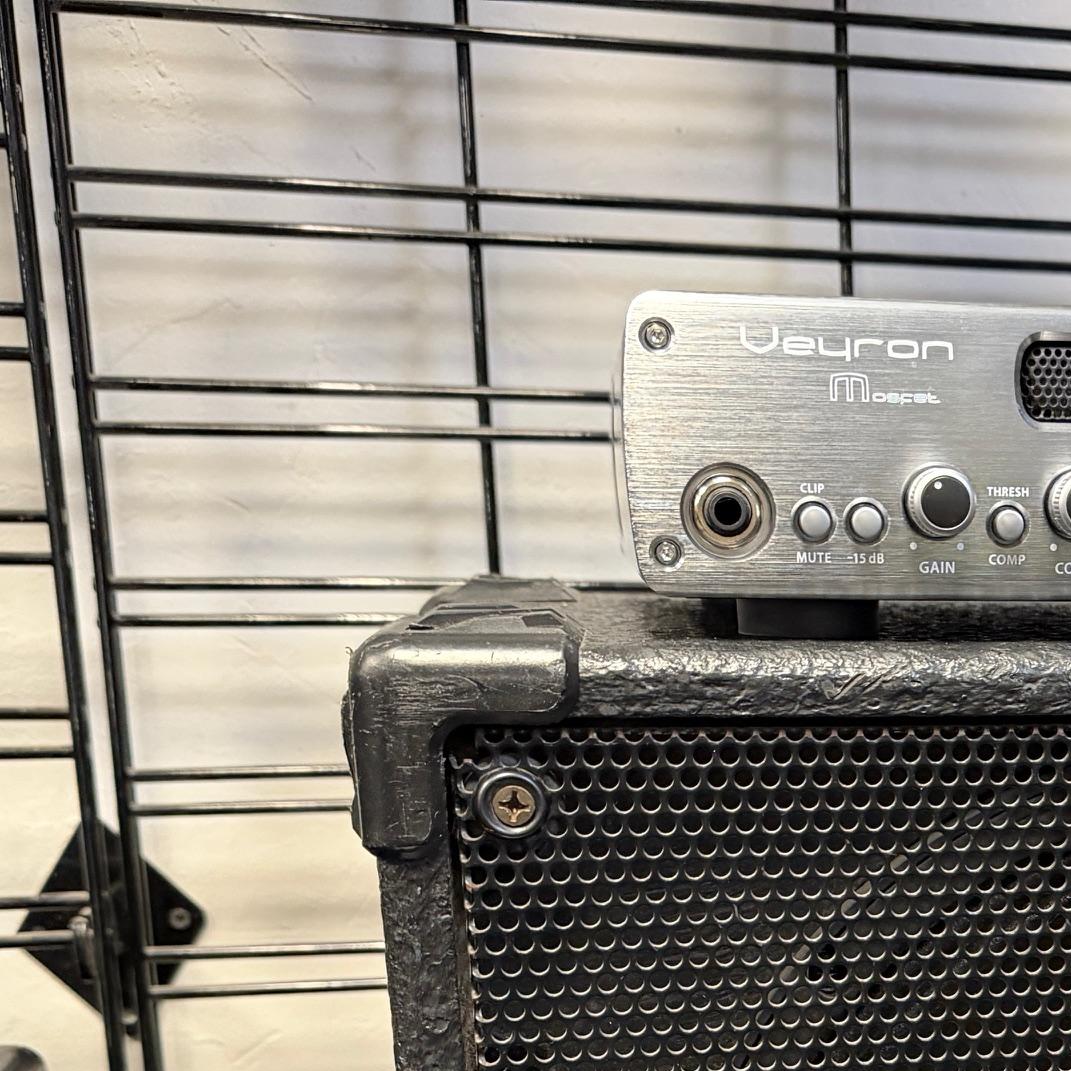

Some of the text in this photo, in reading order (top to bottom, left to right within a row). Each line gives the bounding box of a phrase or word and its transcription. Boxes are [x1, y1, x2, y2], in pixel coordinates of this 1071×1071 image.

[738, 325, 954, 361] Veyron
[800, 483, 825, 494] CLIP
[987, 486, 1029, 498] THRESH
[796, 551, 831, 563] MUTE
[869, 553, 884, 564] dB
[988, 554, 1026, 566] COMP
[919, 561, 956, 574] GAIN
